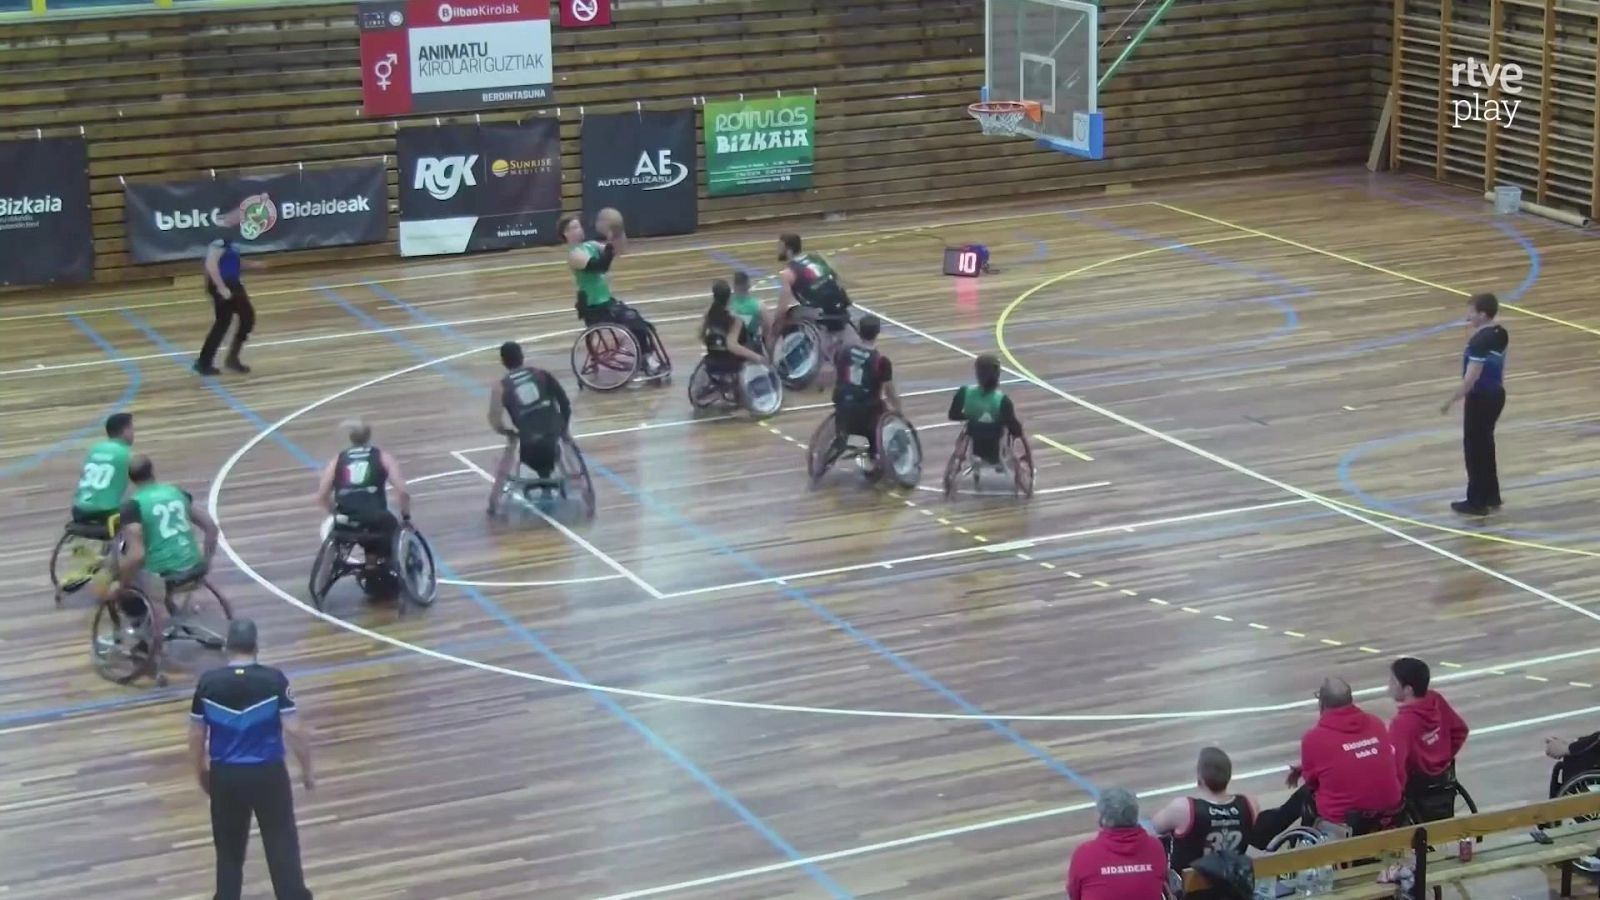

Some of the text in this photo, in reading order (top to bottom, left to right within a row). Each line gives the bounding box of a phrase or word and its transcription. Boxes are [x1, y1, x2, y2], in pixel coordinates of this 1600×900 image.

[418, 42, 488, 61] ANIMATU
[419, 53, 544, 77] KIROLARI GUZTIAK
[482, 89, 546, 103] BERDINTASUNA
[634, 149, 672, 177] AE
[598, 177, 630, 187] AUTOS
[281, 194, 370, 219] Bidaideak
[959, 252, 977, 273] 10
[79, 462, 115, 490] 30
[152, 500, 190, 539] 23
